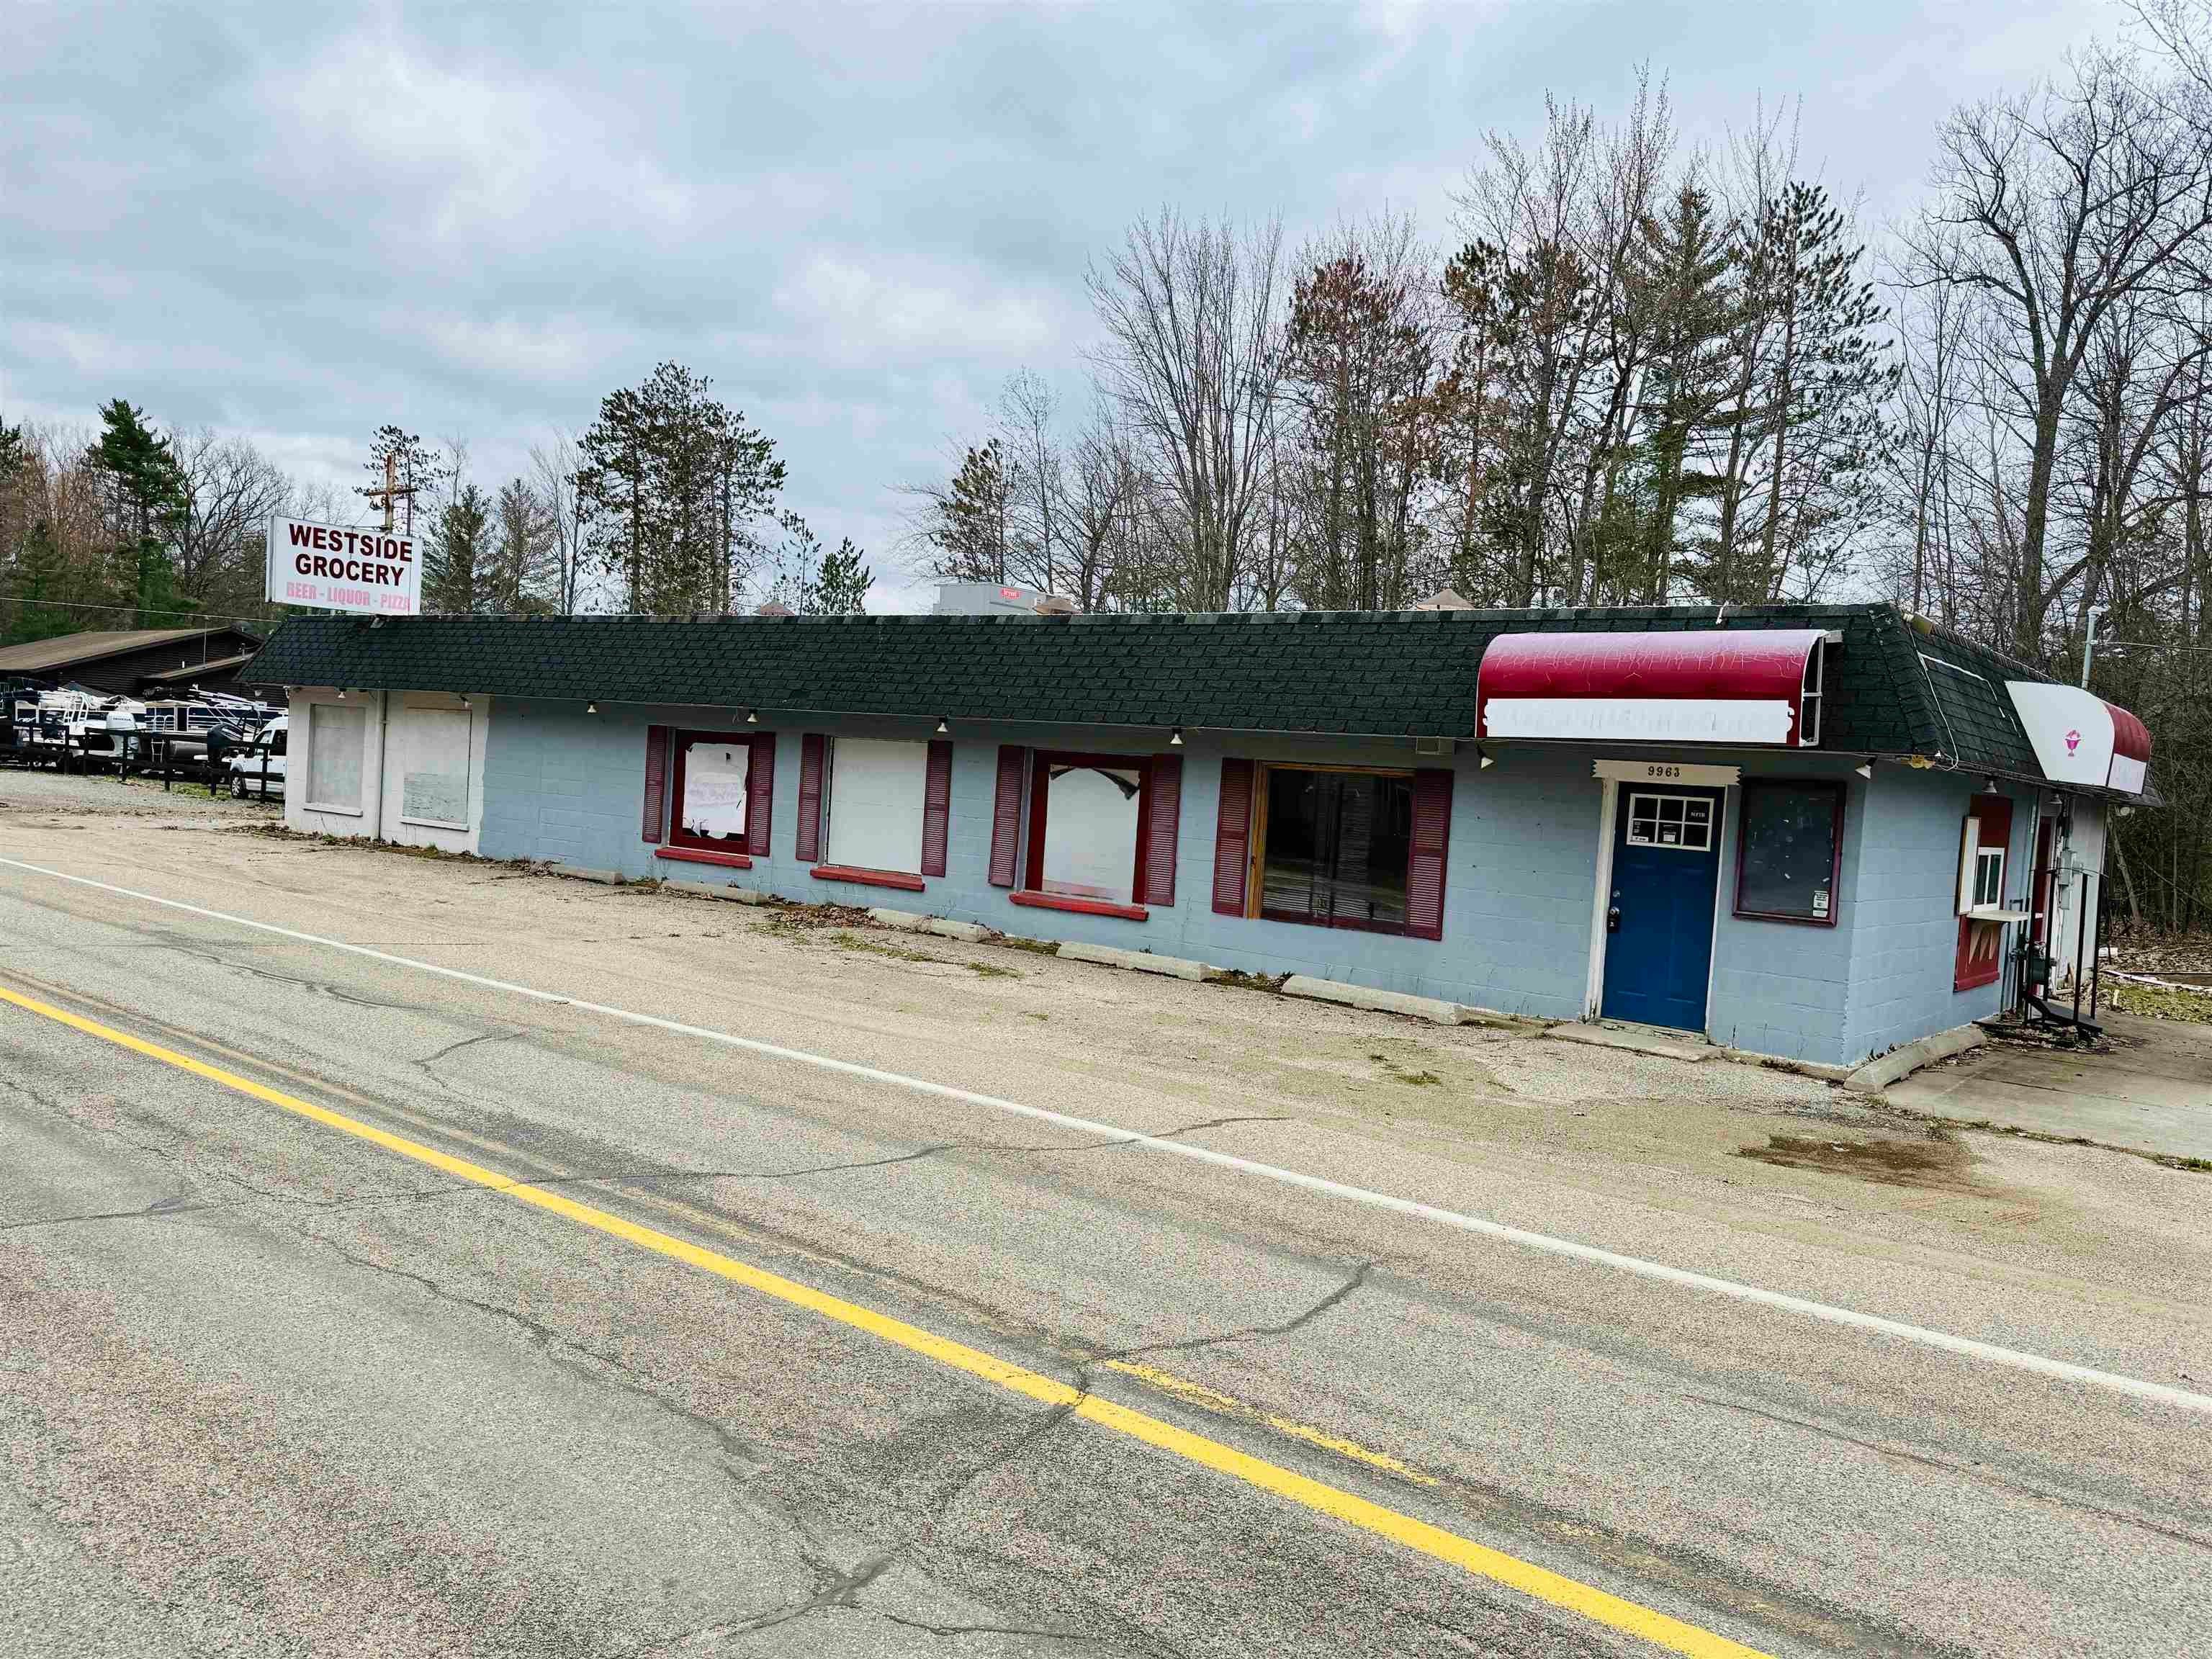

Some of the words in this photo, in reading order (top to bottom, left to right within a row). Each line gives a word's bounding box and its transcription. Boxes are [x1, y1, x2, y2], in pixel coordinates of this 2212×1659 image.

[289, 523, 413, 562] WESTSIDE
[295, 553, 404, 586] GROCERY
[287, 582, 317, 600] BEER
[328, 587, 370, 606] LIQUOR
[1647, 765, 1680, 777] 9963
